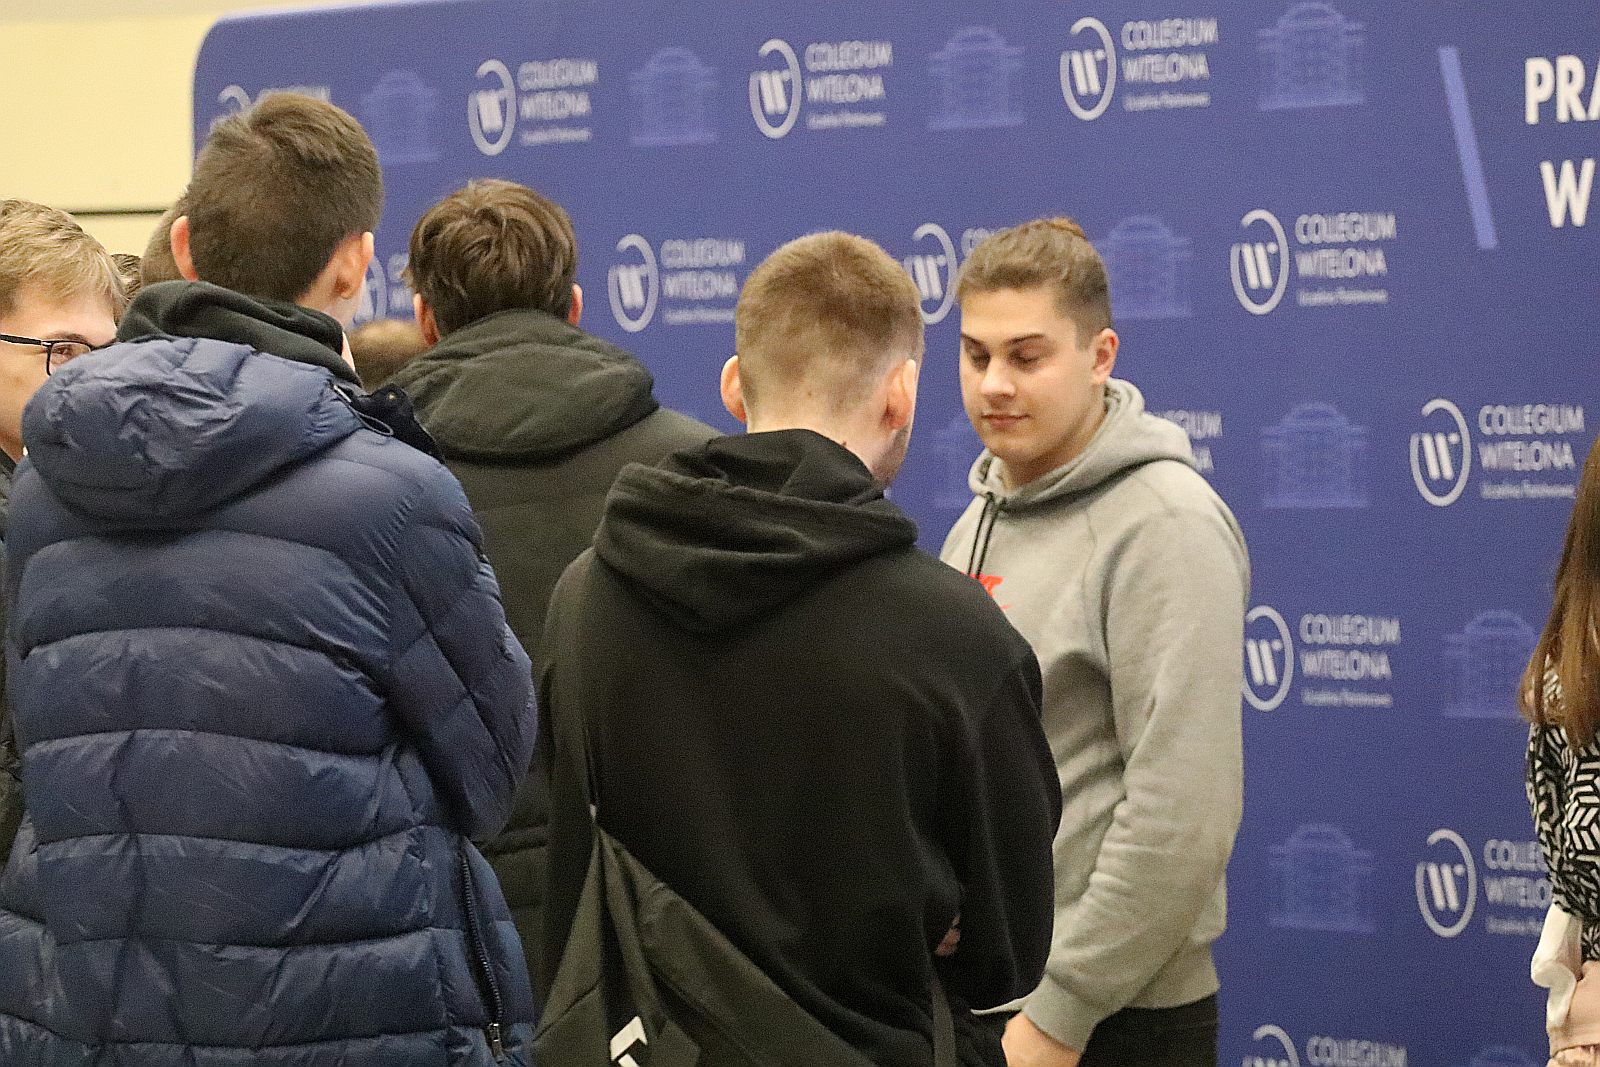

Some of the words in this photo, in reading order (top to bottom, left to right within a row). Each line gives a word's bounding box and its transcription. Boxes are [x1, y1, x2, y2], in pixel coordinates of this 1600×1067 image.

[1120, 18, 1219, 50] COLLEGIUM
[804, 41, 893, 72] COLLEGIUM
[1122, 53, 1210, 83] WITELONA
[1295, 212, 1397, 244] COLLEGIUM
[1295, 248, 1388, 279] WITELONA
[1478, 404, 1585, 436] COLLEGIUM
[1477, 441, 1576, 471] WITELONA
[1300, 613, 1400, 645] COLLEGIUM
[1300, 650, 1392, 681] WITELONA
[1484, 839, 1549, 872] COLLE
[1483, 876, 1553, 908] WITELO
